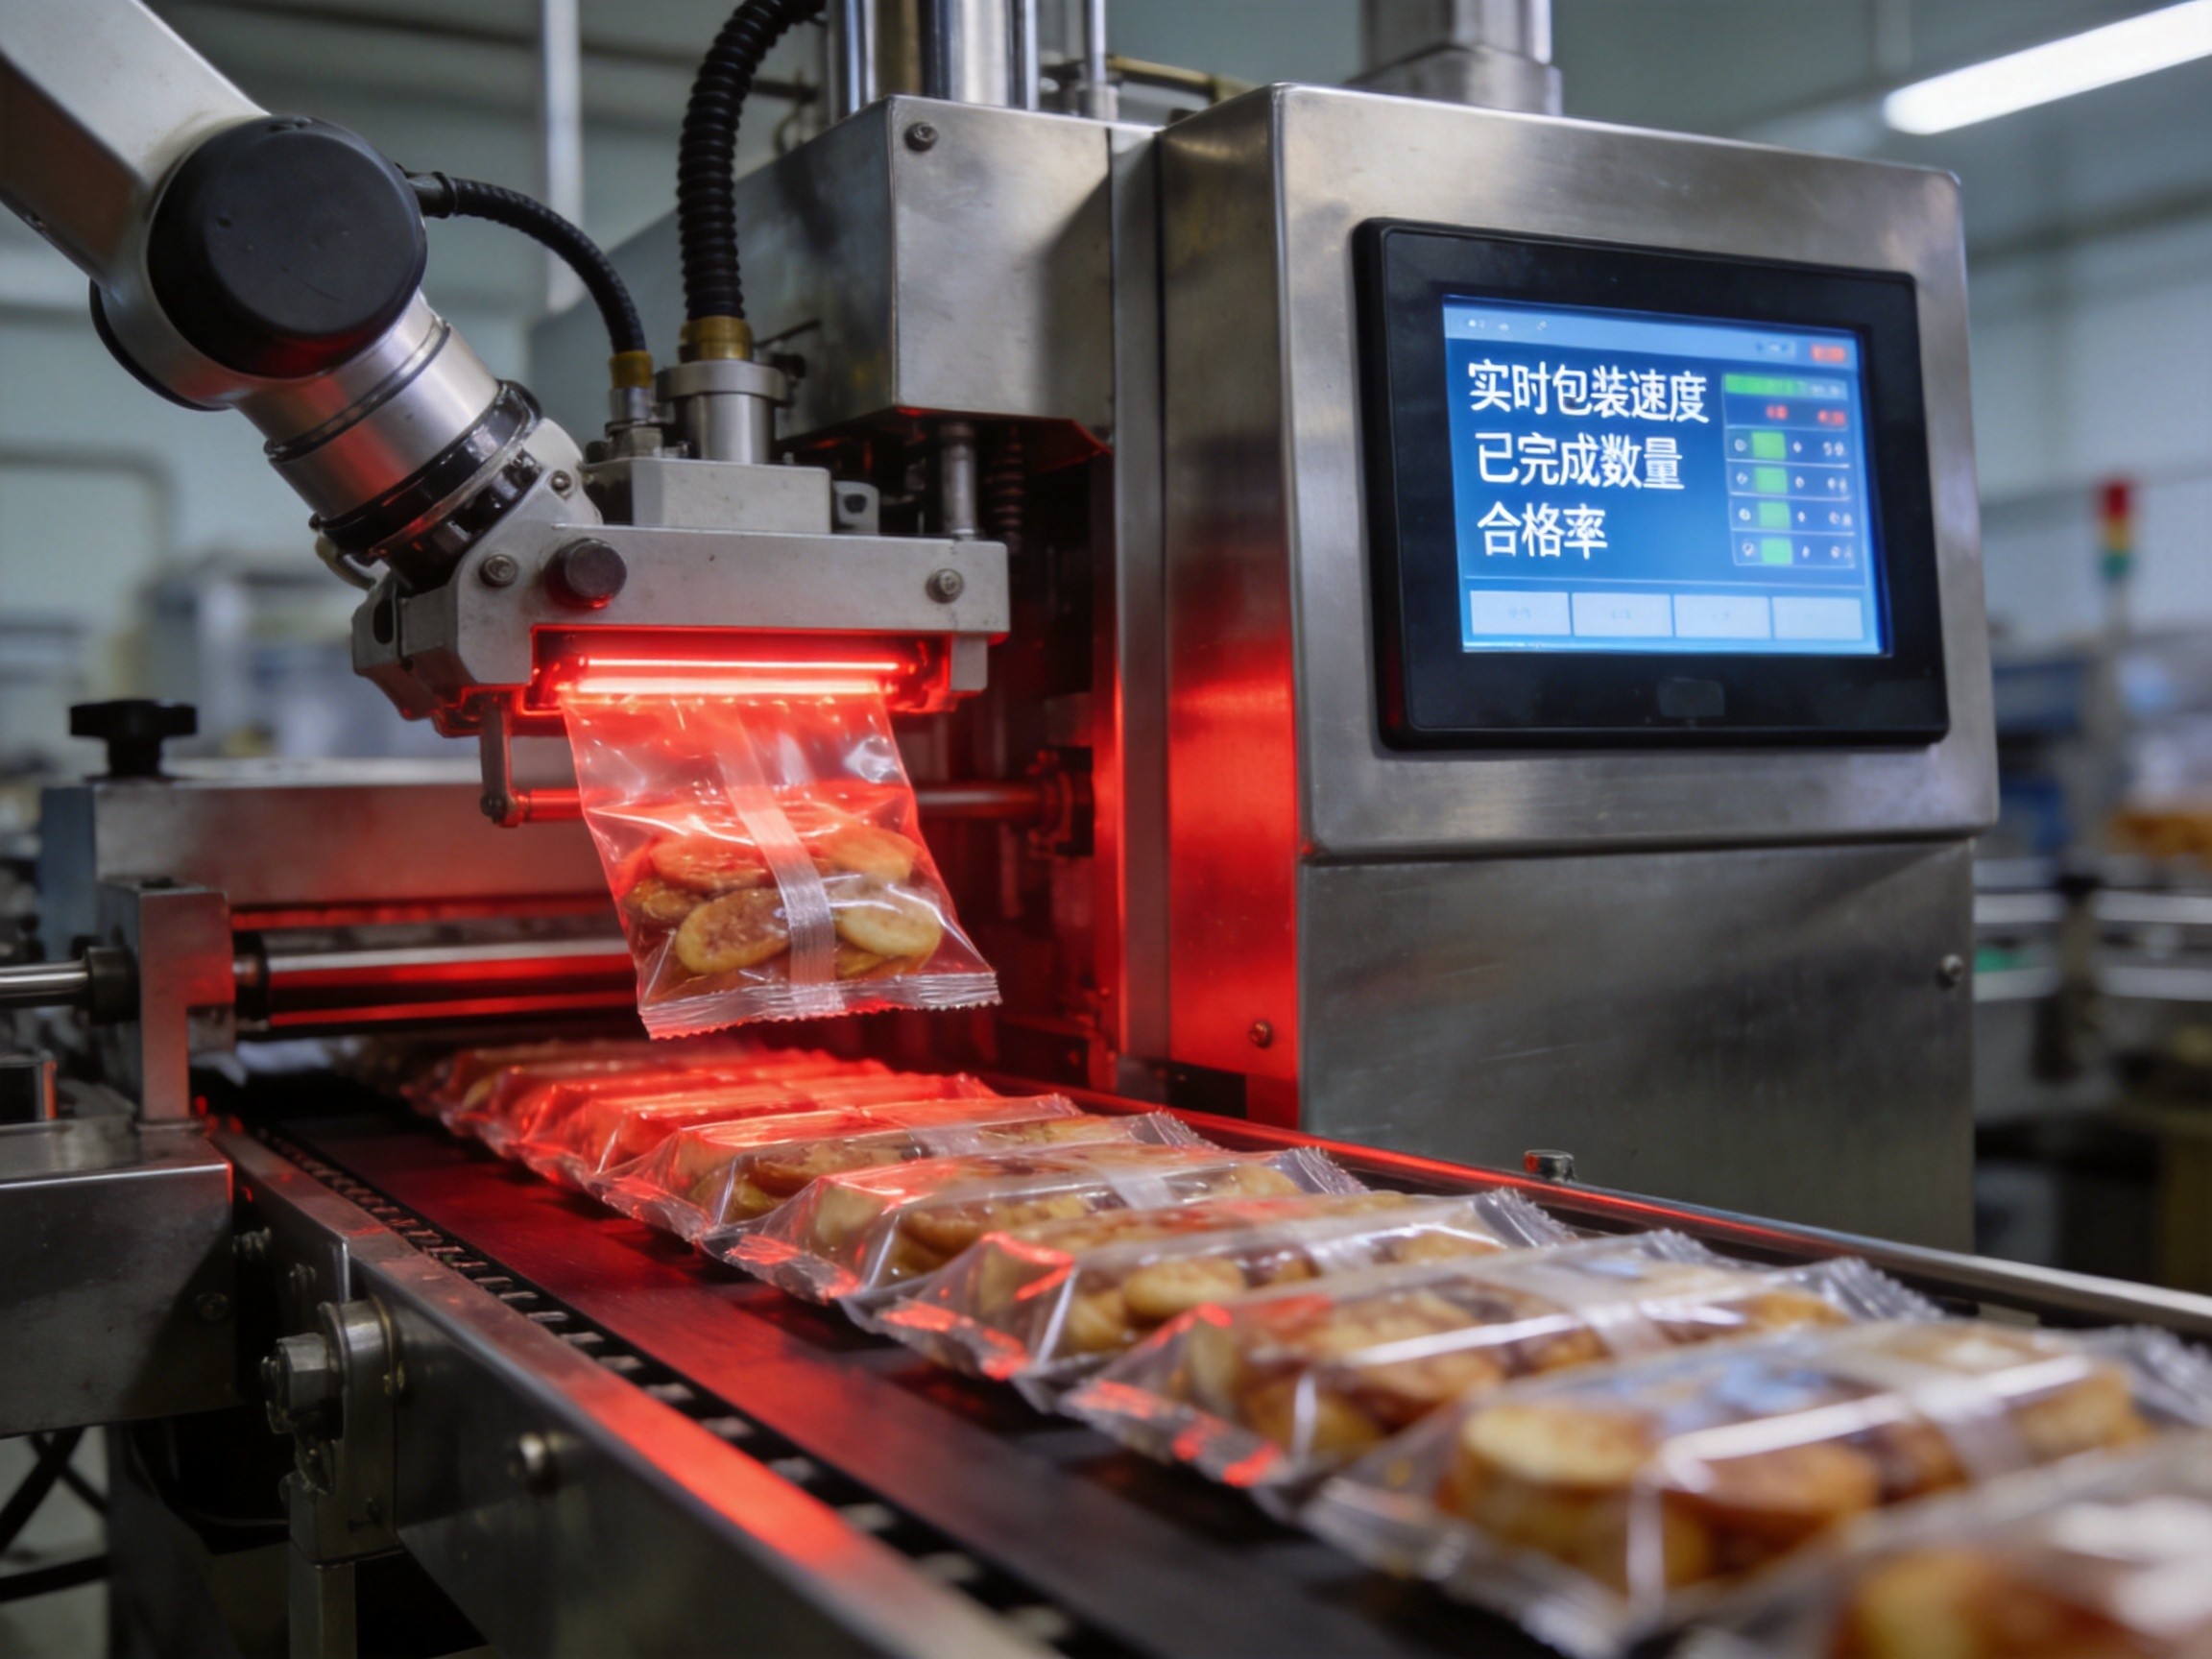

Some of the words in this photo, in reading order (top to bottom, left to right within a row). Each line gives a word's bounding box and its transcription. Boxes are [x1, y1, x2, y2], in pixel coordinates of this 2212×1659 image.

[1467, 358, 1710, 424] 实时包装速度
[1475, 431, 1685, 492] 已完成数量
[1477, 501, 1608, 561] 合格率
